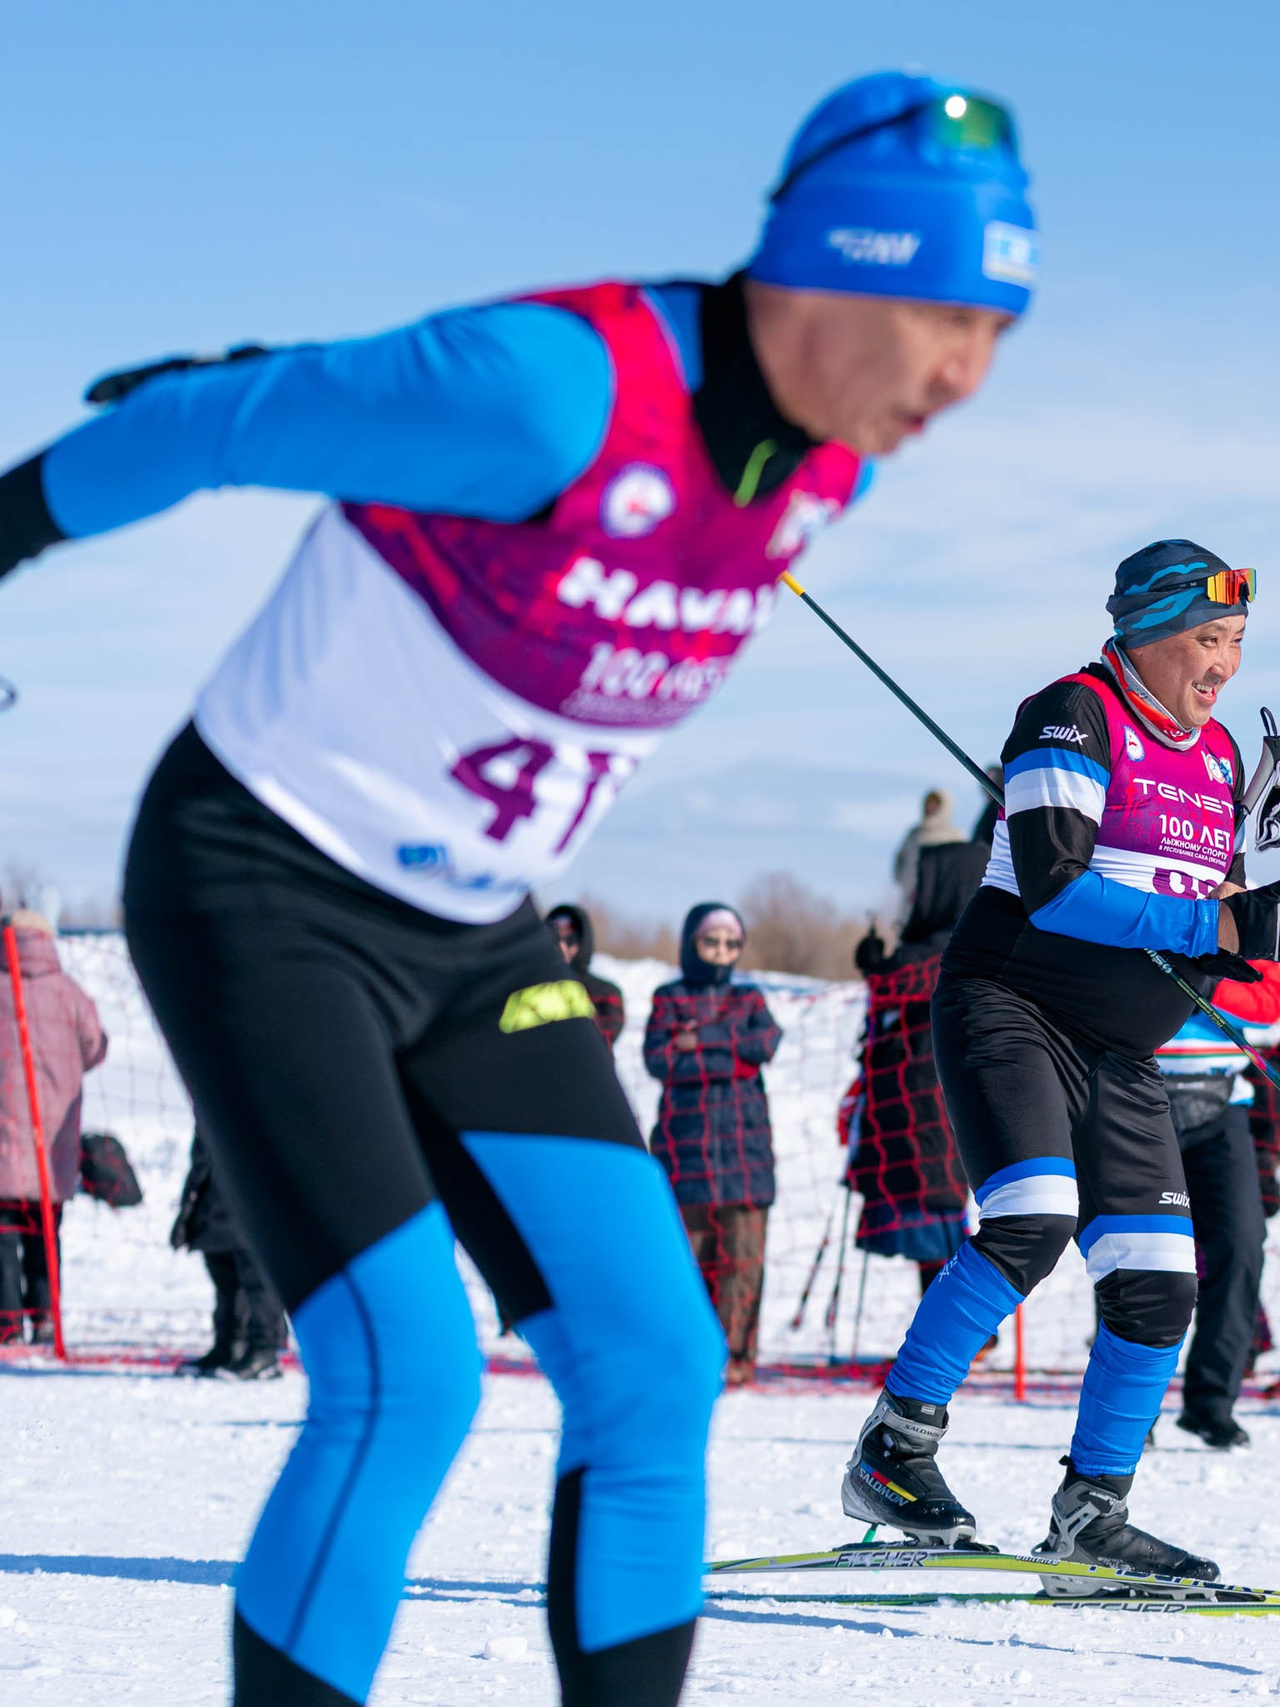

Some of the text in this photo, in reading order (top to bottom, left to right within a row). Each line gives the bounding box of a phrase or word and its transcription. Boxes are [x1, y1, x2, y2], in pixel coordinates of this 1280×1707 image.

[1133, 778, 1234, 818] TENET
[1159, 814, 1231, 852] 100 ЛЕТ
[1160, 836, 1228, 861] ЛЫЖНОМУ СПОРТУ
[1194, 852, 1209, 861] САХА
[858, 1466, 909, 1507] SALOMON
